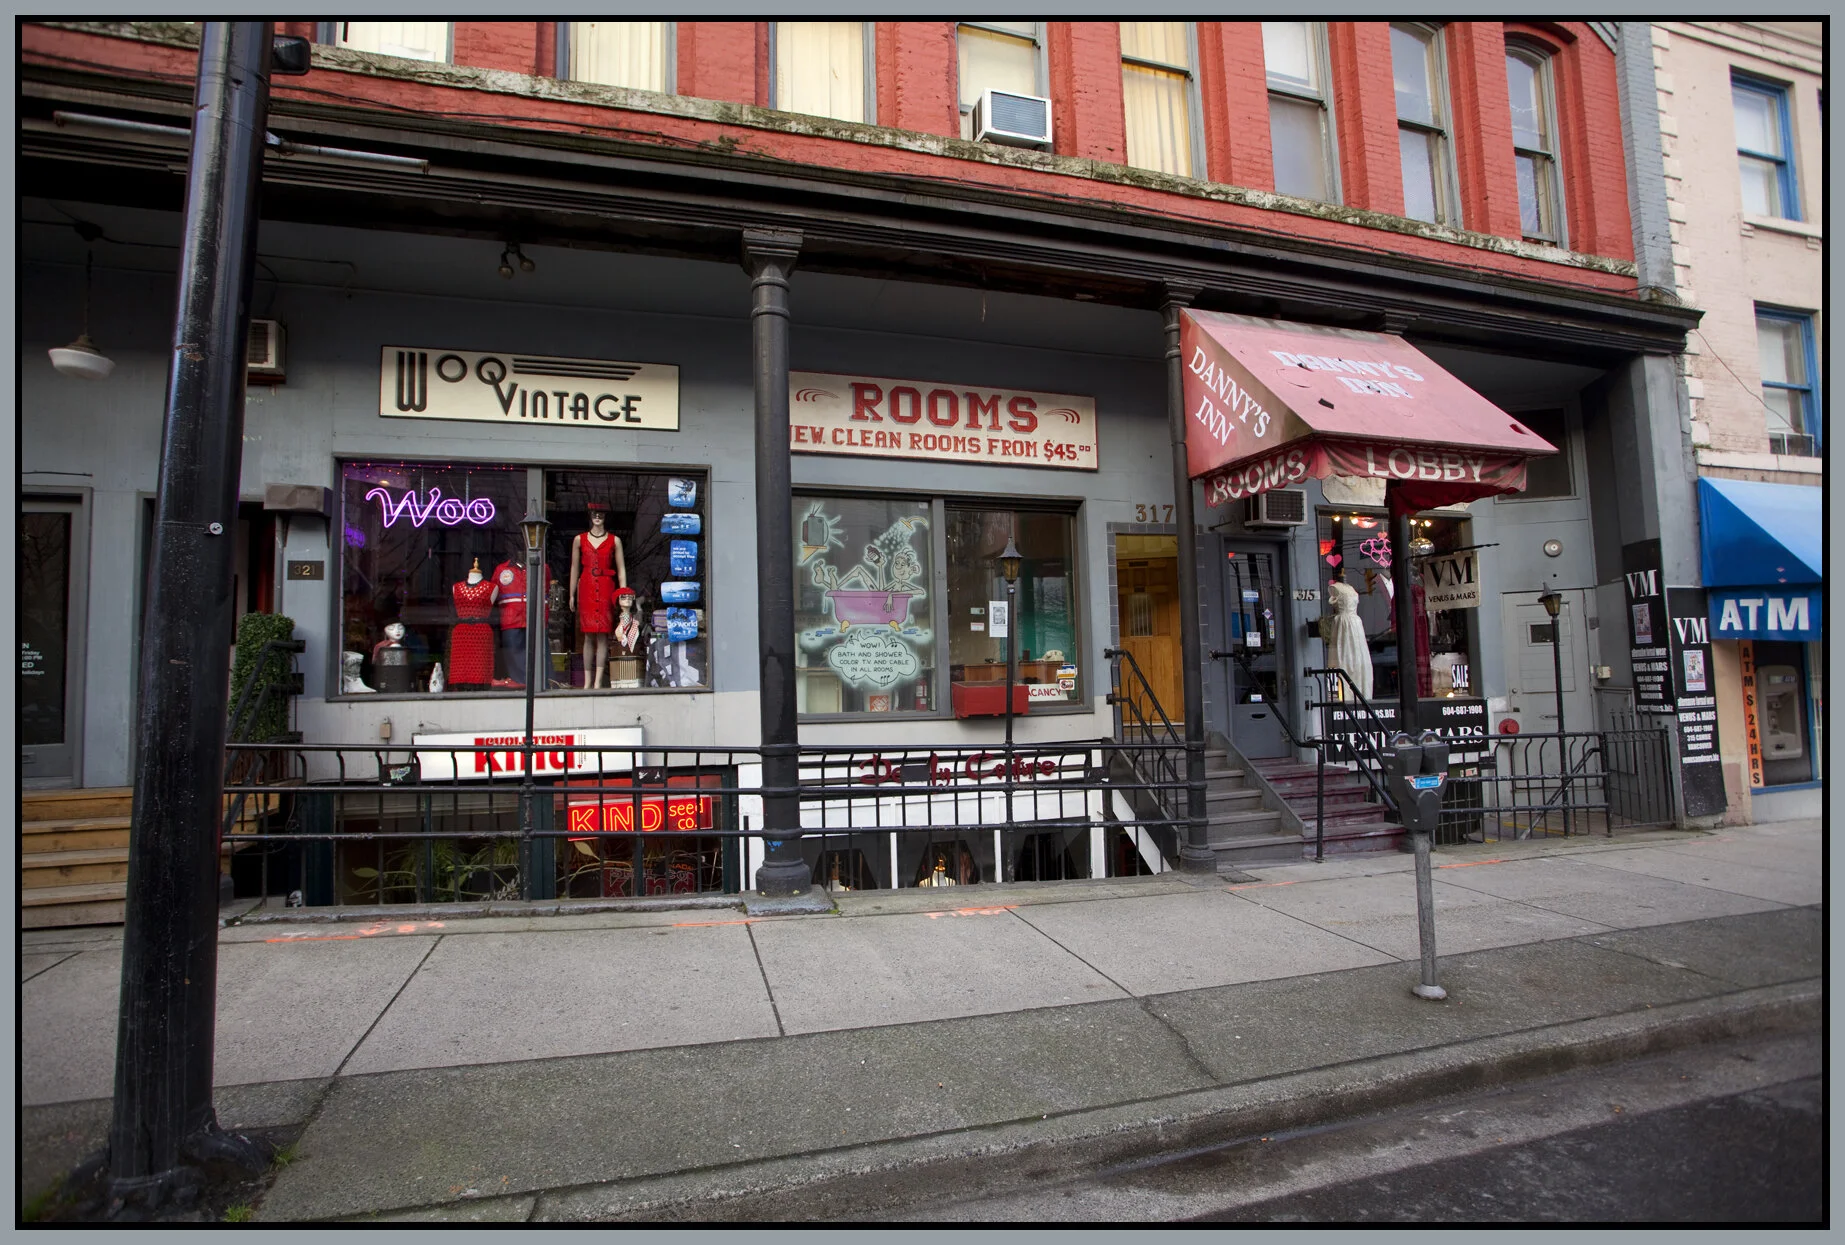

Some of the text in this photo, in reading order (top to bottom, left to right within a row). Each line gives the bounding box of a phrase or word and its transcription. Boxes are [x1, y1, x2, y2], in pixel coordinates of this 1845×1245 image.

[487, 370, 642, 423] VINTAGE
[1188, 346, 1271, 438] DANNY'S
[848, 382, 1038, 434] ROOMS
[1195, 395, 1235, 447] INN
[831, 427, 902, 449] CLEAN
[909, 433, 981, 453] ROOMS
[987, 438, 1038, 458] FROM
[1208, 449, 1307, 504] ROOMS
[1366, 447, 1485, 483] LOBBY
[365, 487, 495, 528] Woo
[1135, 504, 1174, 523] 317
[294, 564, 316, 576] 321
[1427, 557, 1475, 588] VM
[1626, 569, 1659, 599] VM
[1297, 588, 1315, 601] 315
[1720, 597, 1809, 631] ATM
[1673, 617, 1710, 645] VM
[1452, 664, 1469, 688] SALE
[1028, 687, 1062, 697] ACANCY
[1679, 712, 1696, 722] VENUS
[572, 804, 662, 832] KIND
